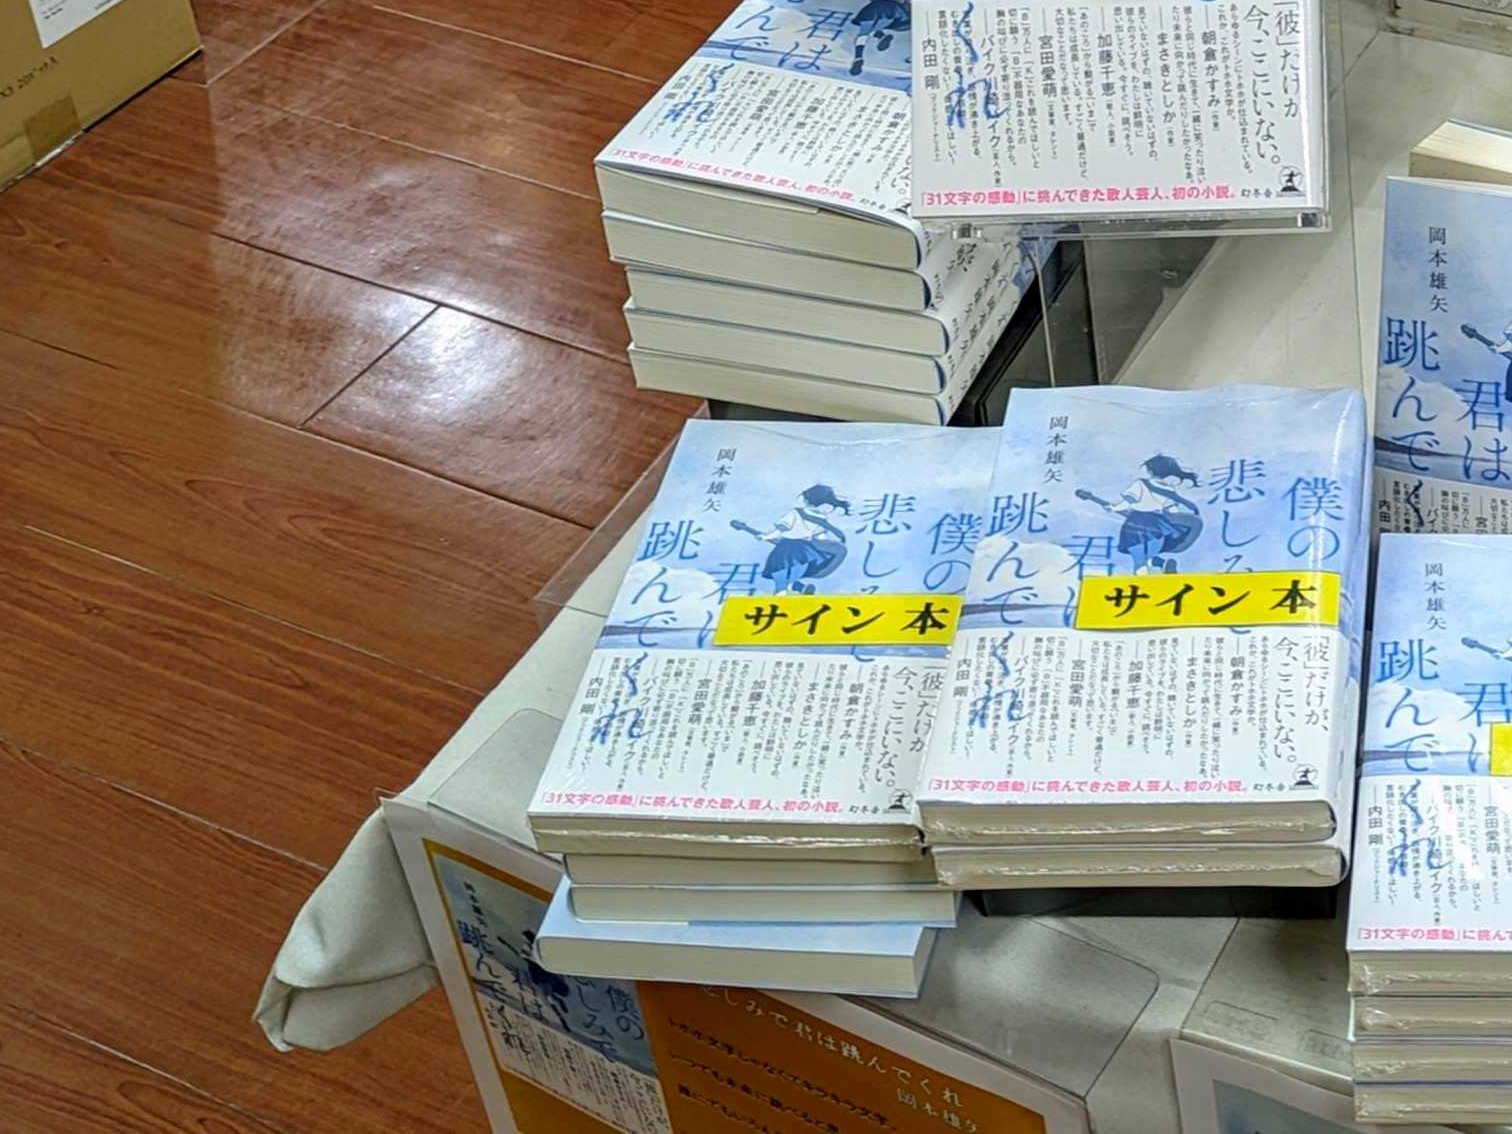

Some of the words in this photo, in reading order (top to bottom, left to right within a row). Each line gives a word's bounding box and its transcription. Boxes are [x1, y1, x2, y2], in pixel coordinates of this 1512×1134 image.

[778, 8, 854, 73] 君は
[1038, 34, 1058, 99] 宮田愛萌
[1097, 33, 1117, 98] 加藤千恵
[1157, 32, 1177, 124] まさきとしか
[1201, 30, 1222, 109] 朝倉かすみ
[1242, 4, 1282, 165] 今、ここにいない。
[920, 185, 1237, 208] 「31文字の感動」に挑んできた歌人芸人、初の小説。
[1427, 225, 1449, 315] 岡本雄矢
[1042, 415, 1069, 484] 岡本雄矢
[1454, 379, 1512, 484] 君は
[701, 447, 738, 514] 岡本雄矢
[1282, 476, 1344, 560] 僕の
[923, 511, 983, 594] 僕の
[590, 519, 705, 745] 跳んでくれ
[743, 601, 951, 636] サイン本
[967, 491, 1049, 730] 跳んでくれ
[1103, 578, 1319, 618] サイン本
[1424, 562, 1447, 631] 岡本雄矢
[874, 664, 919, 788] 今、ここにいない。
[1227, 655, 1247, 717] 朝倉かすみ
[1271, 636, 1301, 764] 今、ここにいない。
[1375, 638, 1450, 878] 跳んでくれ
